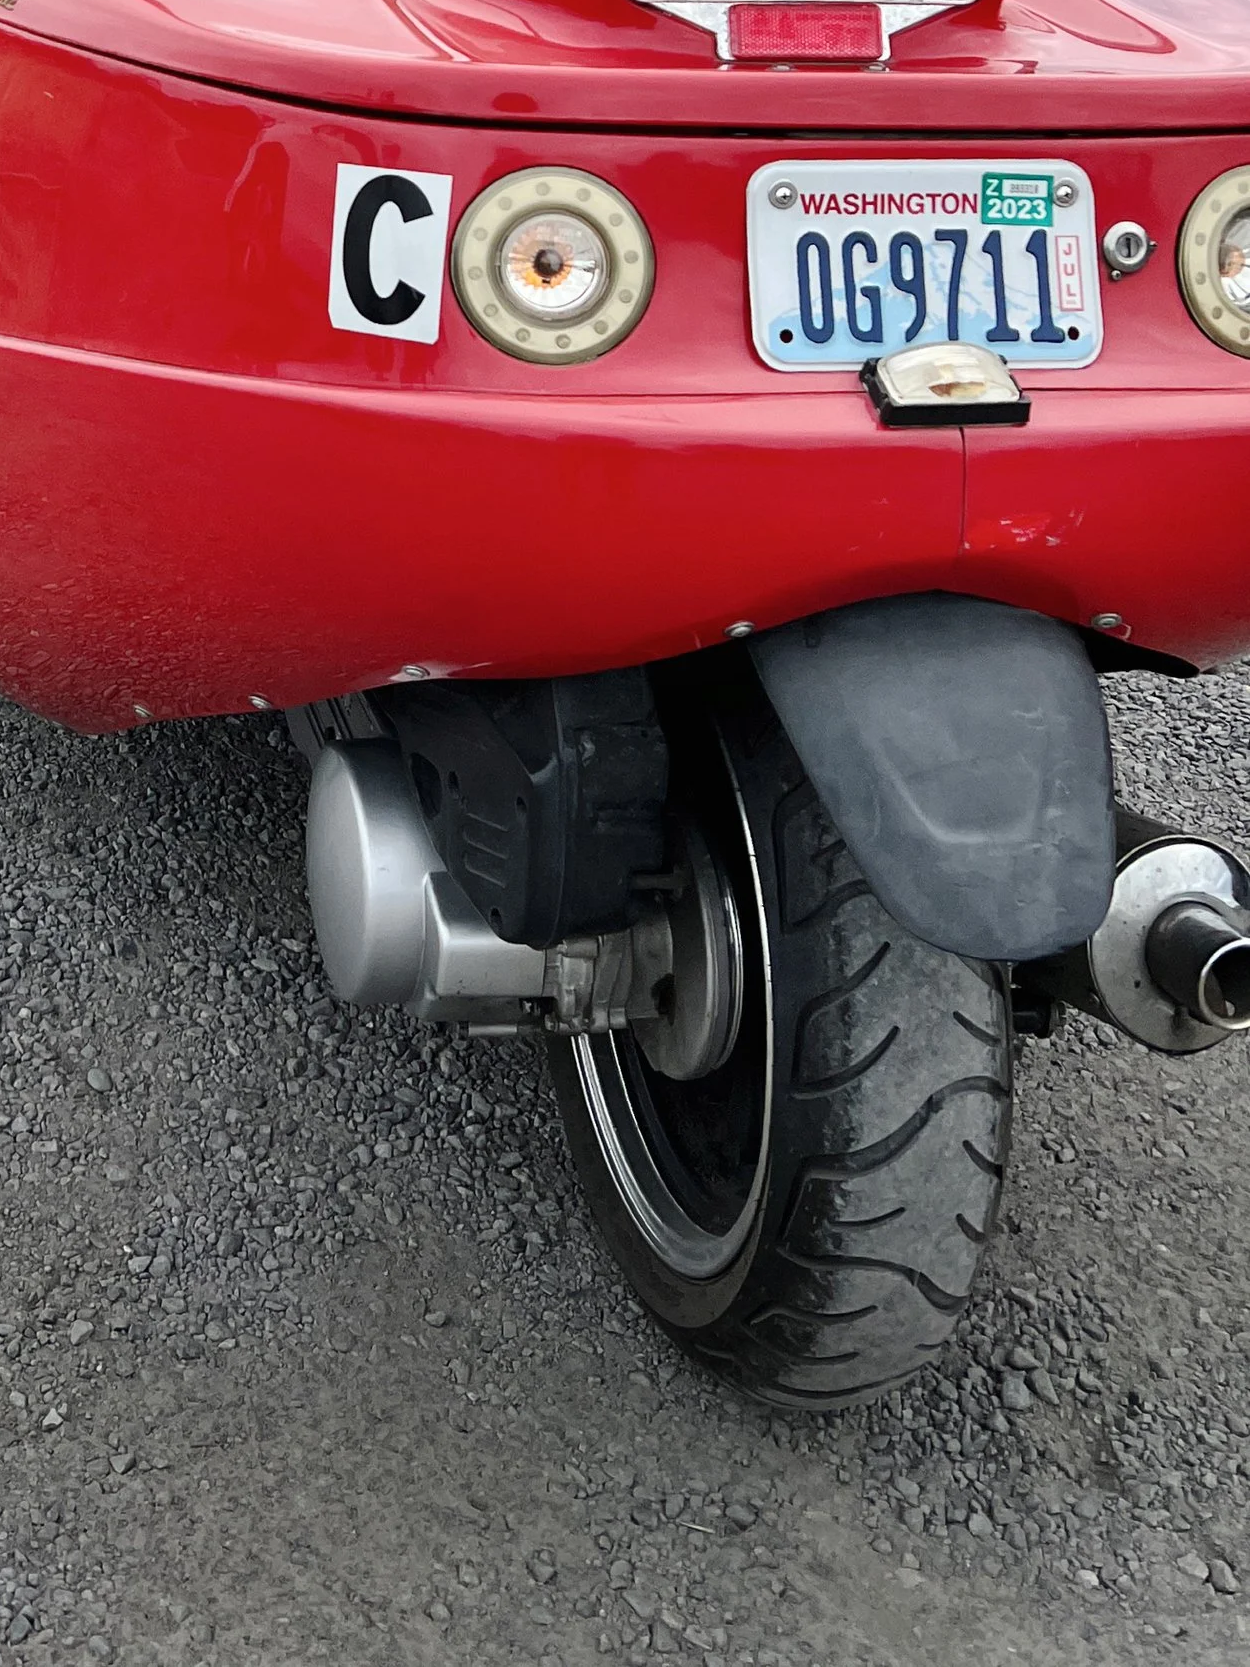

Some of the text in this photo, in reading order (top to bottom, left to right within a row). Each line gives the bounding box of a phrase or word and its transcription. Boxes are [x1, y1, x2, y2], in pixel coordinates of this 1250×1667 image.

[985, 178, 1000, 196] Z
[799, 192, 979, 215] WASHINGTON
[987, 197, 1048, 220] 2023
[342, 174, 434, 325] C
[1063, 242, 1077, 298] JUL
